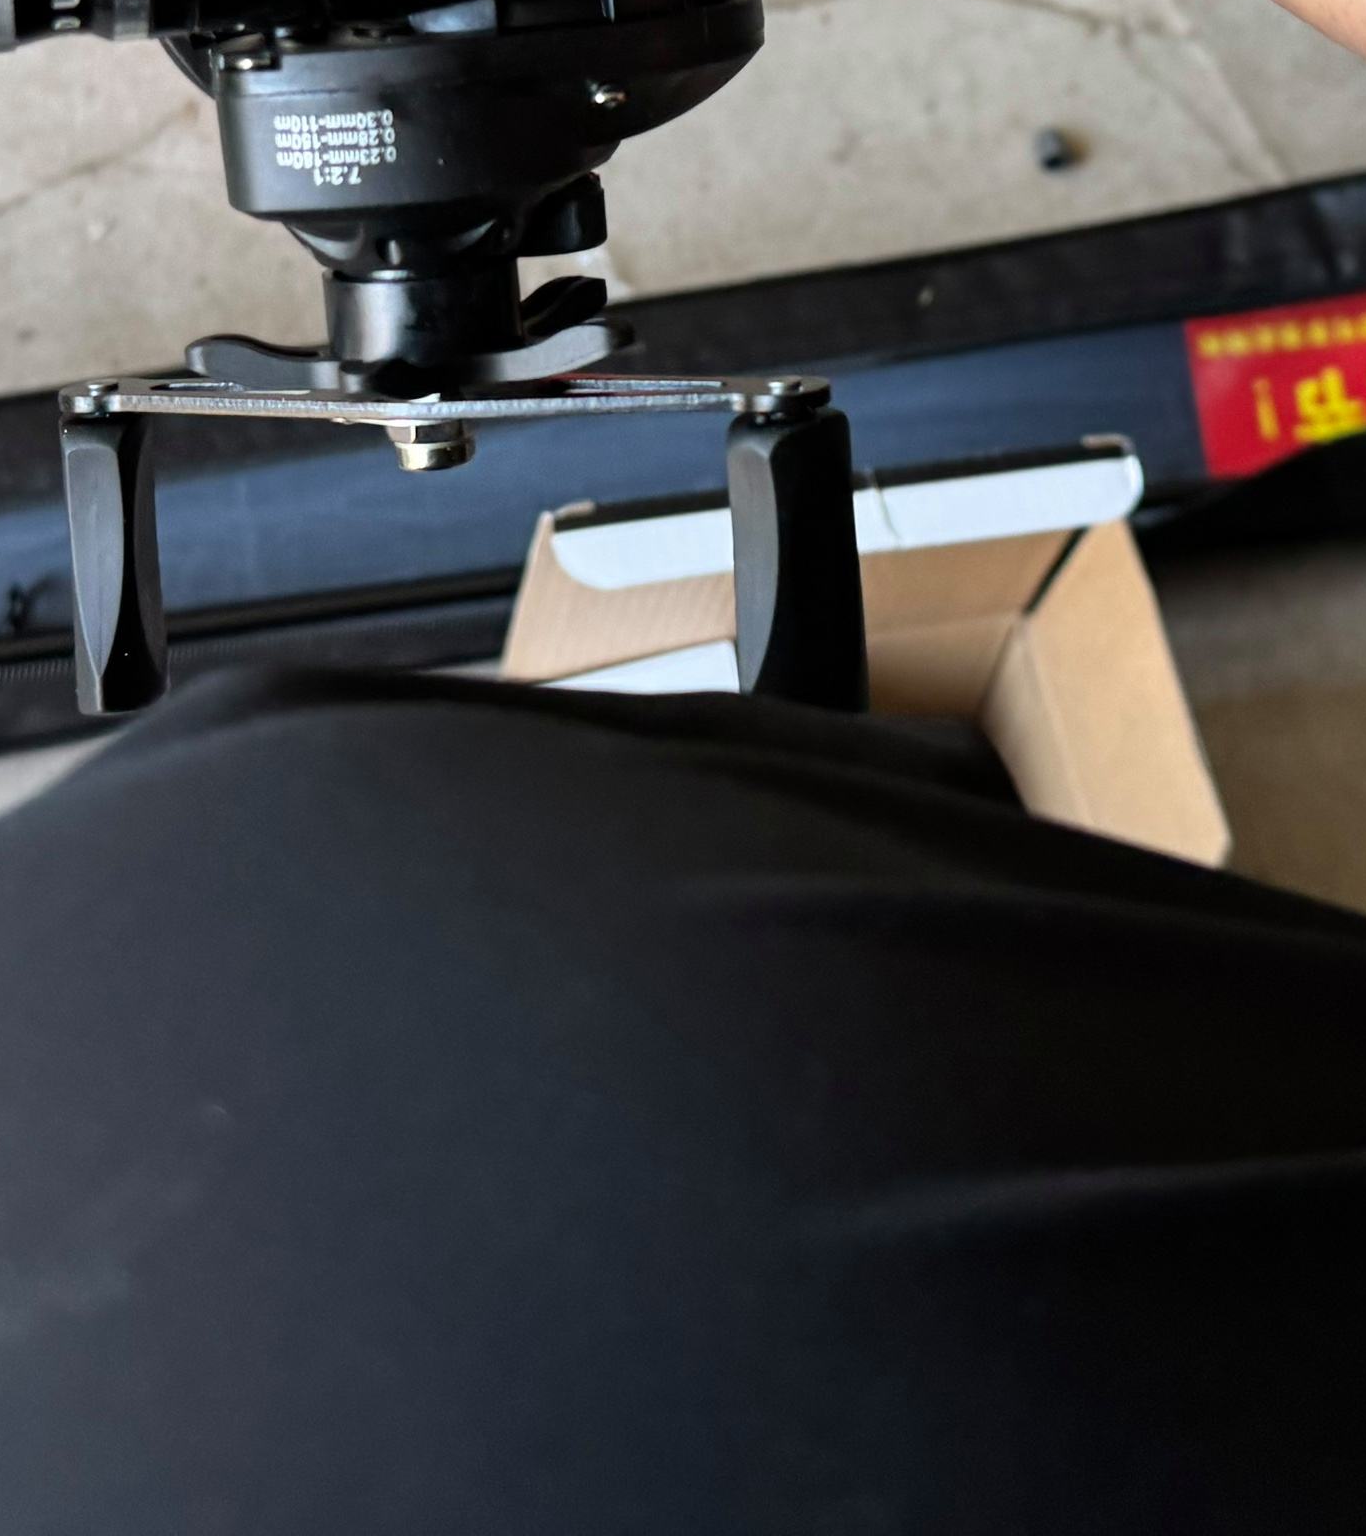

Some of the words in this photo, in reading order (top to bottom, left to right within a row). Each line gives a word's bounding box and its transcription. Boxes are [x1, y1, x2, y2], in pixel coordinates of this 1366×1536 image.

[274, 109, 394, 133] 0.30mm-110m
[275, 127, 396, 150] 0.28mm-150m
[276, 146, 397, 169] 0.23mm-180m
[313, 165, 362, 186] 7.2:1
